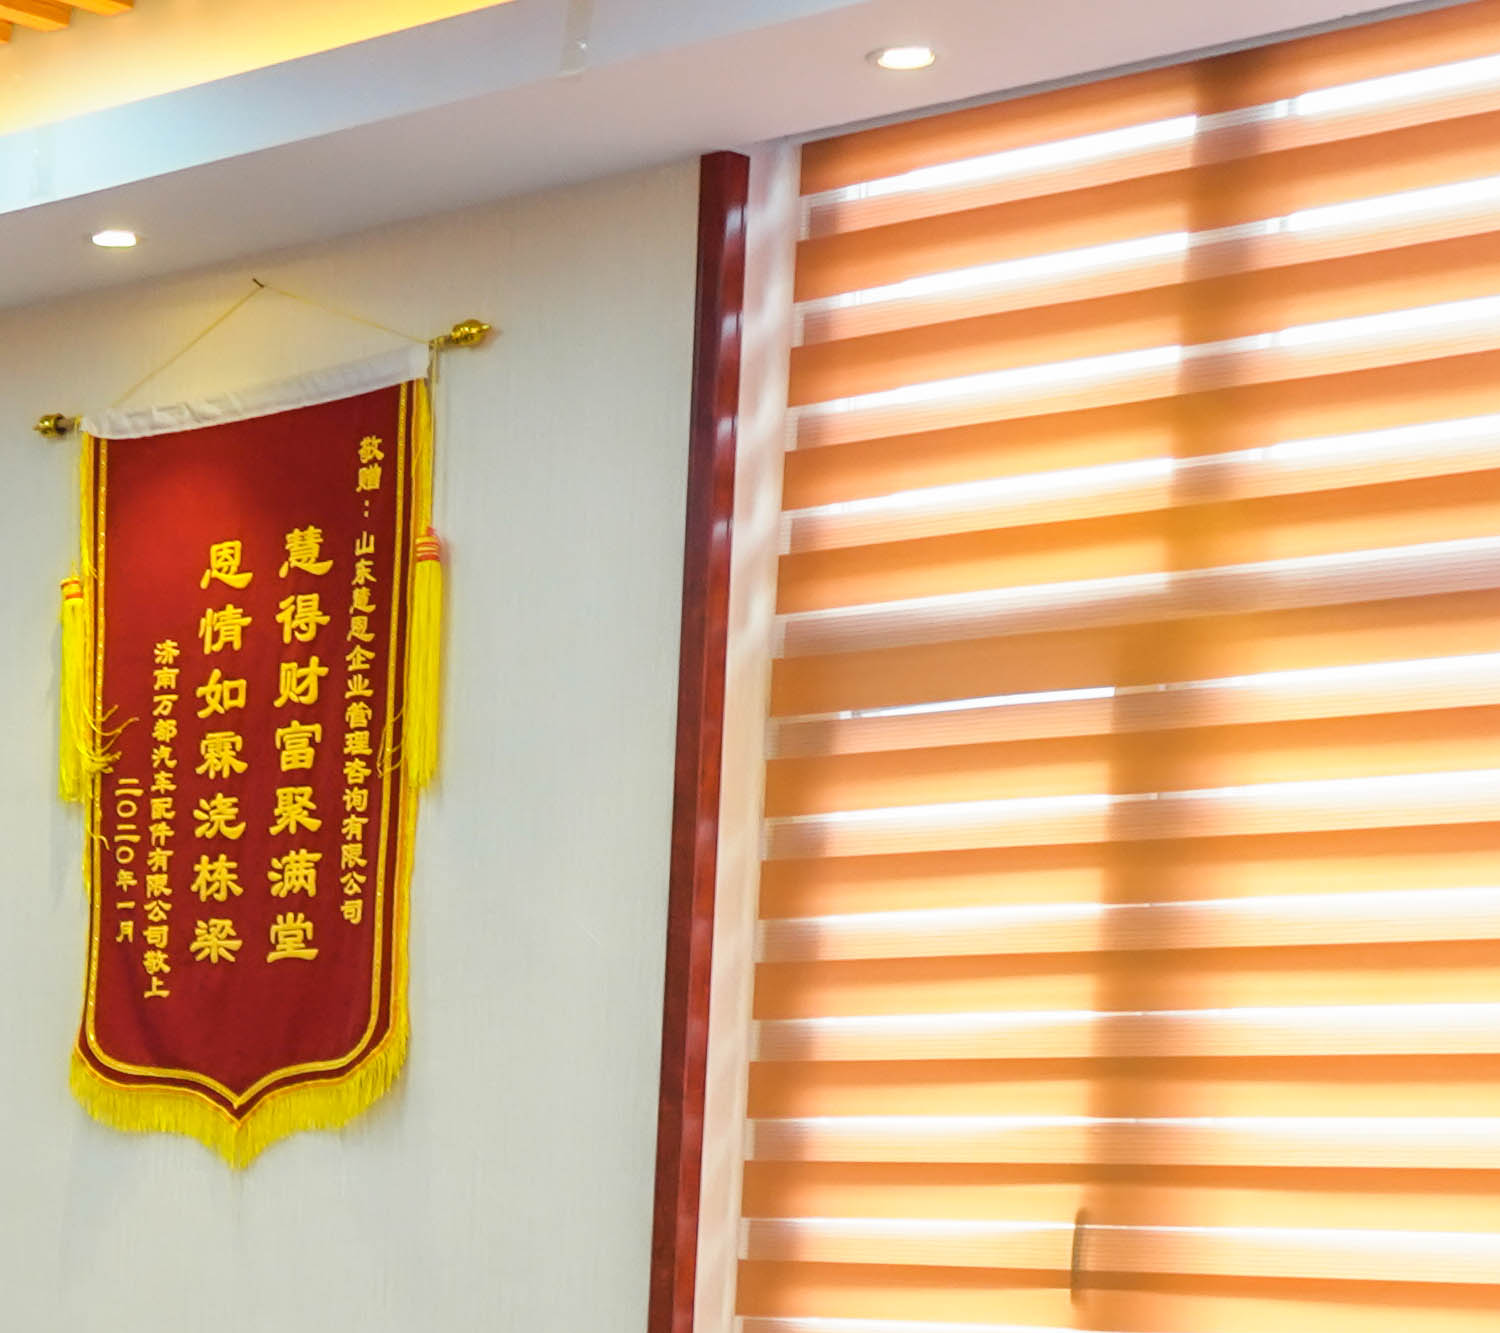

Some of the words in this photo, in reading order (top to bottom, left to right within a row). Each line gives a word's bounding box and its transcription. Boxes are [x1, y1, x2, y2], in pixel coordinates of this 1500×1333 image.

[189, 540, 254, 965] 恩情如霖浇栋梁
[265, 524, 334, 964] 慧得财富聚满堂
